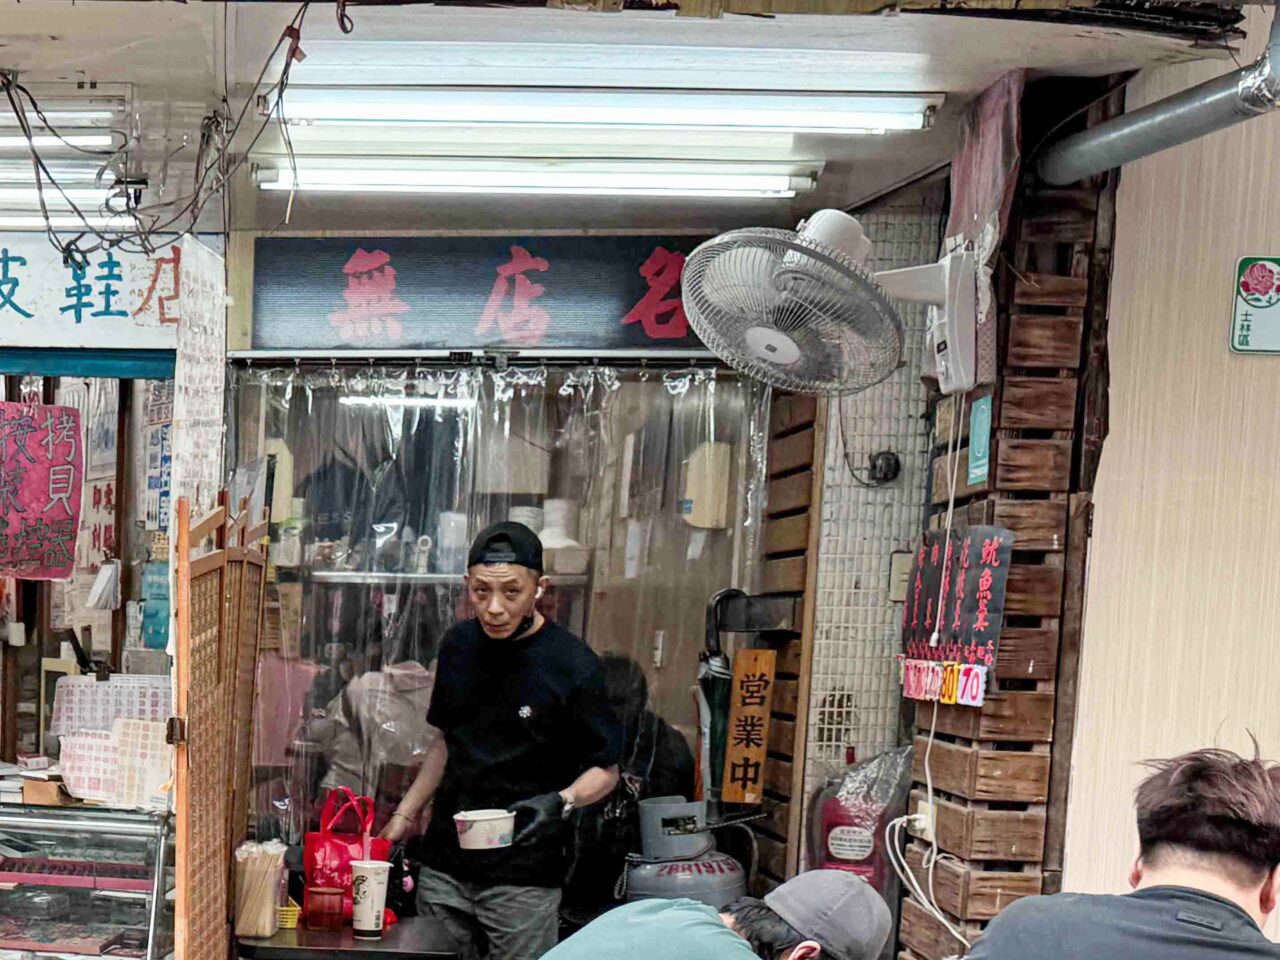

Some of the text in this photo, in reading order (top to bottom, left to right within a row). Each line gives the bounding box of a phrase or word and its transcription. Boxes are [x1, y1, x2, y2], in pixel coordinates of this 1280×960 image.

[327, 245, 688, 344] 無店名
[1238, 309, 1254, 346] 士林區
[39, 410, 77, 517] 拷貝
[960, 667, 981, 702] 70
